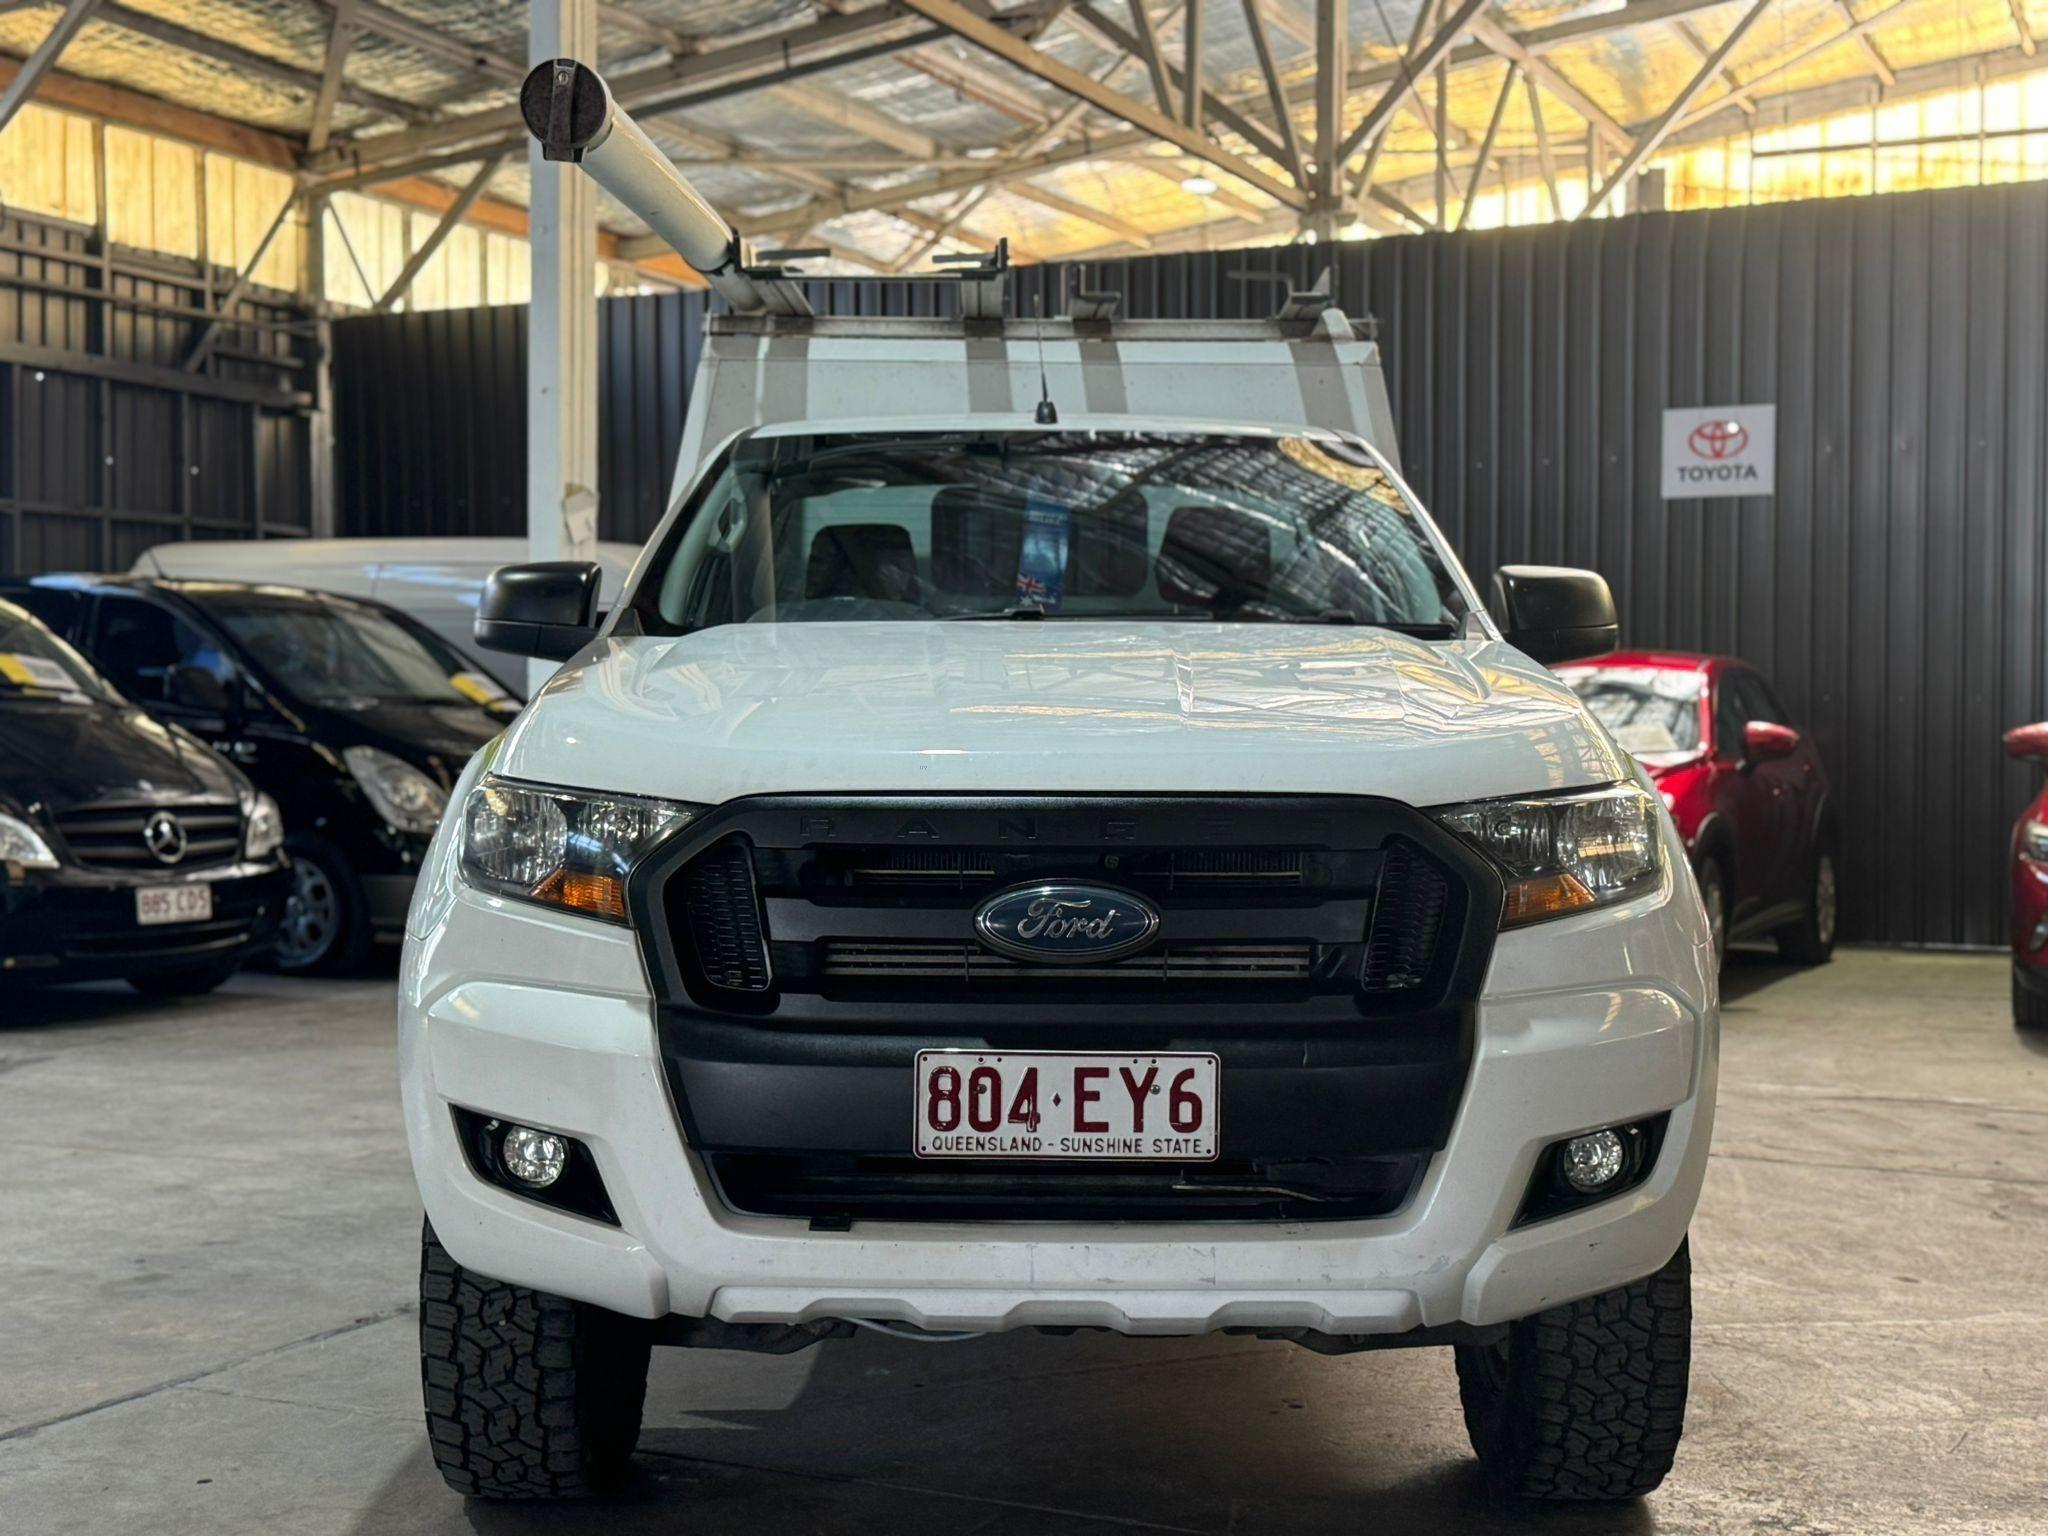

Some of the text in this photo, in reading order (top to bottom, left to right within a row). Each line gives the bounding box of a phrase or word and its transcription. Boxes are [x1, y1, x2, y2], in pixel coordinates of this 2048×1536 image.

[1678, 464, 1759, 482] TOYOTA
[1017, 898, 1121, 939] Ford
[928, 1066, 1203, 1133] 804 EY6
[932, 1136, 1043, 1152] QUEENSLAND
[1060, 1137, 1143, 1153] SUNSHINE
[1153, 1138, 1202, 1154] STATE
